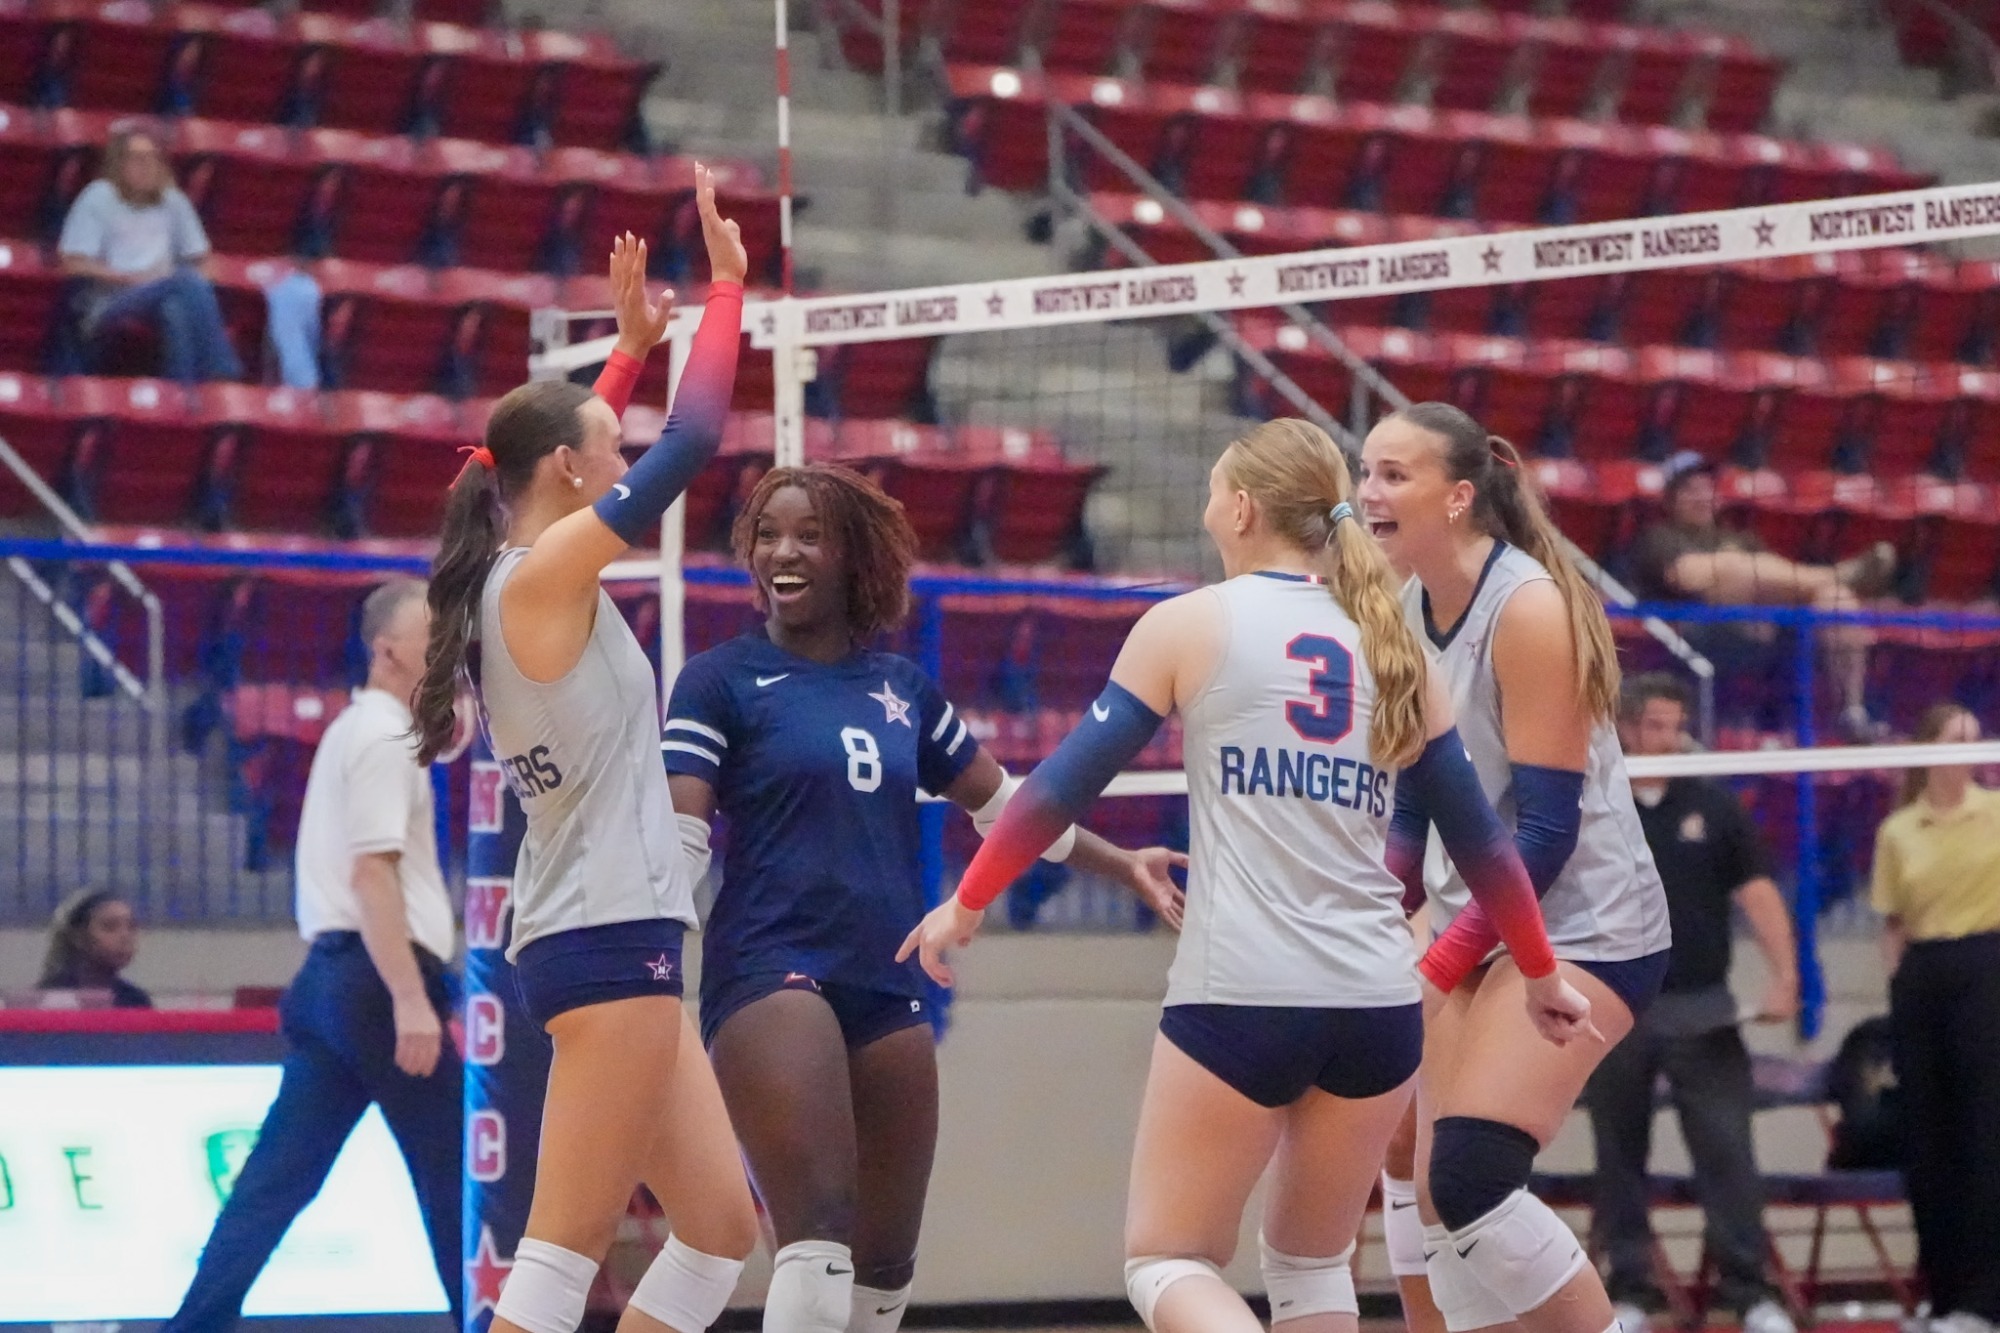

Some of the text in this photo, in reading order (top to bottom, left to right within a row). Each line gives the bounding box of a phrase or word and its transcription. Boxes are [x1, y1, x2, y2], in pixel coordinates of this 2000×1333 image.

[1533, 223, 1720, 268] NORTHWEST RANGERS
[1810, 203, 1915, 241] NORTHWEST
[1277, 250, 1450, 293] NORTHWEST RANGERS
[1285, 632, 1354, 745] 3
[840, 726, 882, 793] 8
[1220, 746, 1389, 818] RANGERS
